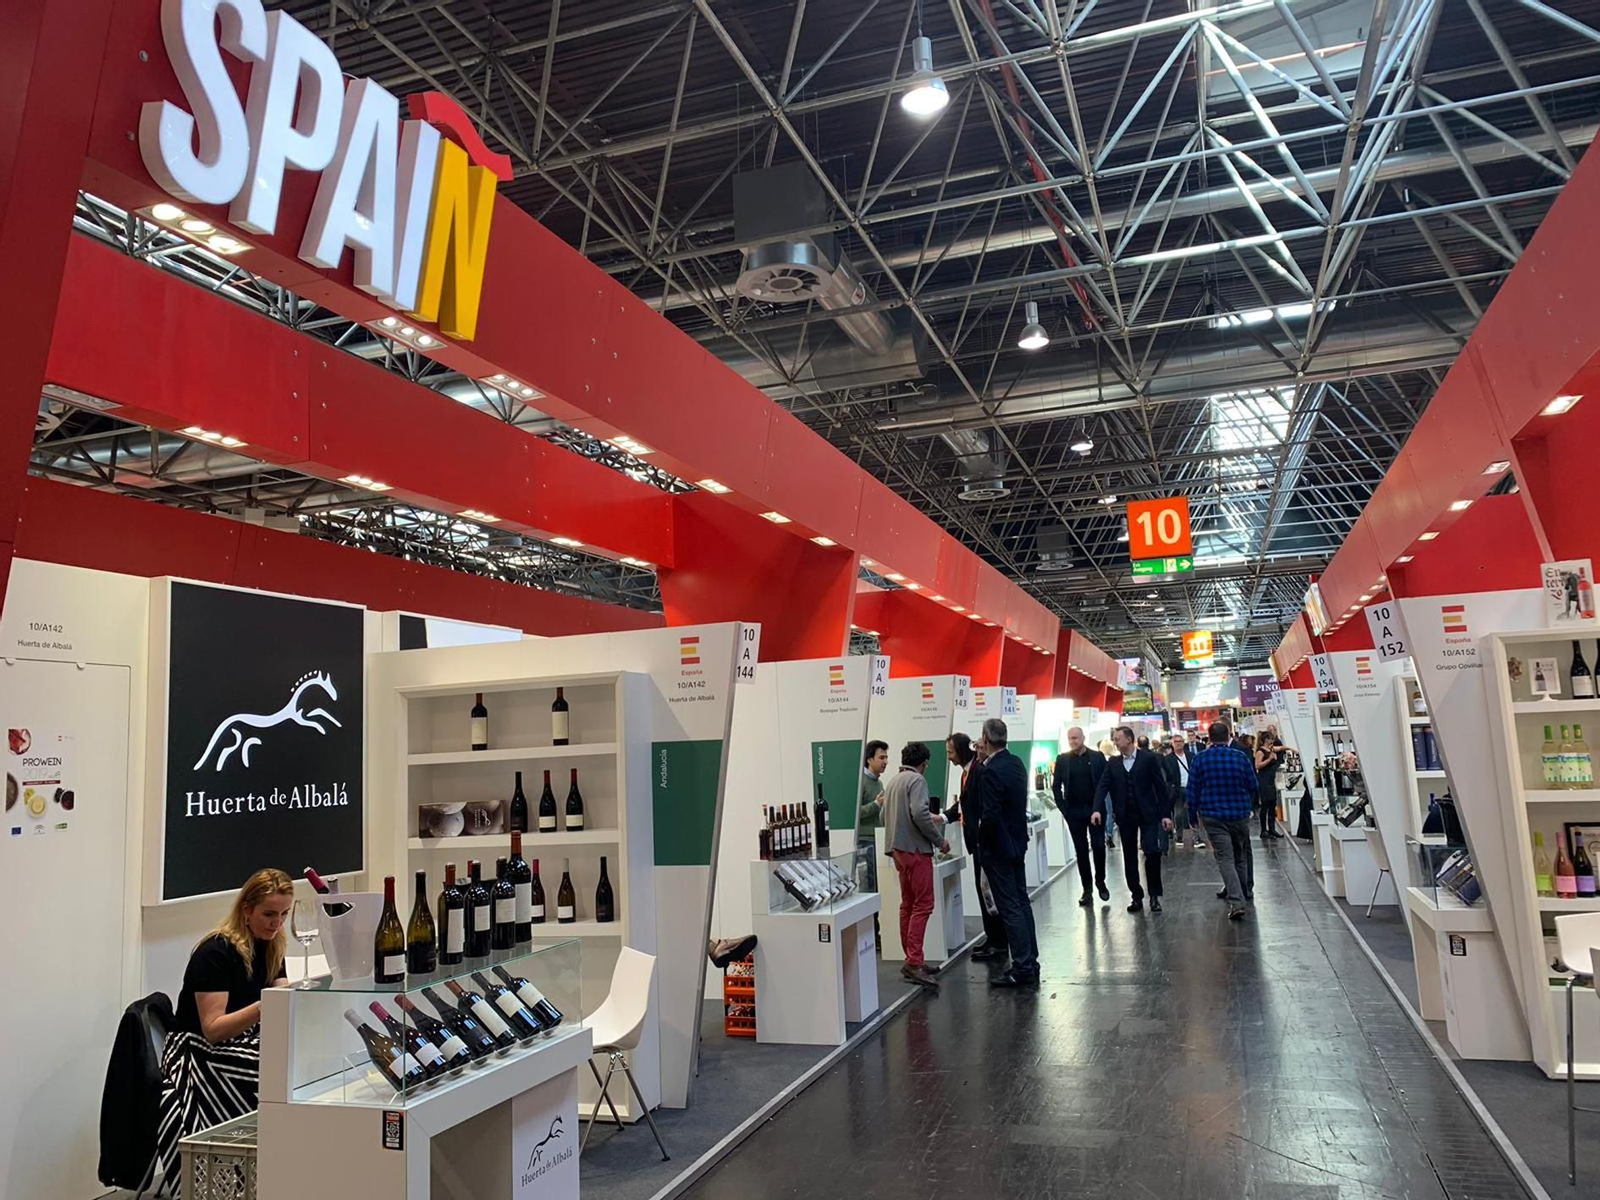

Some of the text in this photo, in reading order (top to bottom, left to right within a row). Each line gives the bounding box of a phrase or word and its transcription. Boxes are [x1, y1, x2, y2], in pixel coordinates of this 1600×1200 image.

[1136, 508, 1182, 546] 10
[1373, 607, 1390, 621] 10
[29, 622, 63, 633] 10/A142
[1382, 626, 1393, 639] A
[744, 628, 755, 641] 10
[17, 639, 73, 650] Huerta de Albalá
[1445, 637, 1472, 645] España
[742, 648, 750, 660] A
[1379, 641, 1406, 657] 152
[1442, 648, 1476, 657] 10/A152
[876, 660, 886, 668] 10
[1314, 657, 1325, 666] 10
[736, 665, 754, 679] 144
[1436, 663, 1457, 671] Grupo
[875, 673, 882, 682] A
[1319, 668, 1327, 677] A
[677, 680, 706, 689] 10/A142
[1317, 678, 1334, 688] 154
[871, 686, 885, 696] 146
[22, 757, 62, 766] PROWEIN
[185, 782, 348, 817] Huerta de Albalá
[521, 1166, 546, 1187] Huerta
[551, 1146, 573, 1169] Albalá
